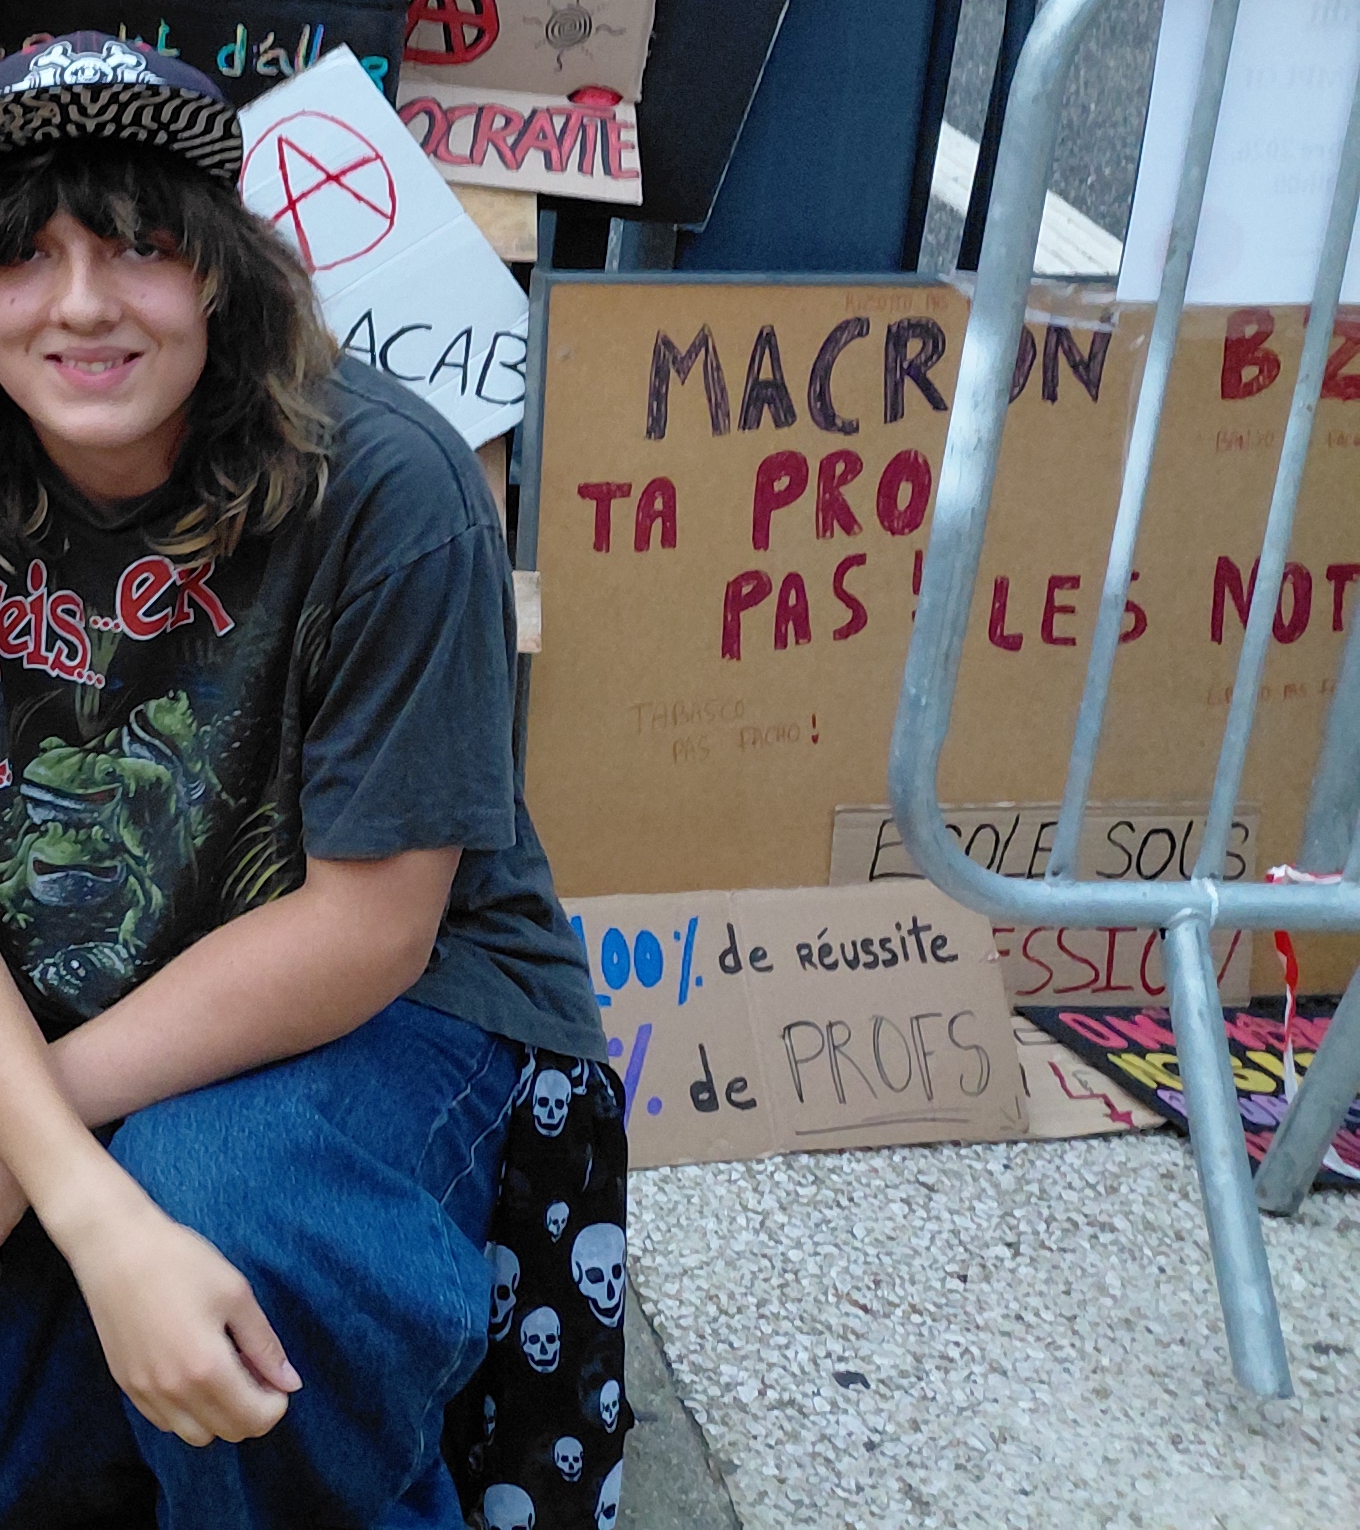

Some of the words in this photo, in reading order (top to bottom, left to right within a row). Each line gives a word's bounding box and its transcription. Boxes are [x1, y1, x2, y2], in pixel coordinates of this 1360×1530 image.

[341, 308, 527, 405] ACAB
[577, 476, 677, 552] TA
[720, 553, 868, 661] PAS
[988, 571, 1148, 651] LES
[869, 812, 1060, 881] EOLE
[718, 922, 774, 975] de
[690, 1043, 758, 1113] de
[781, 1008, 992, 1106] PROFS
